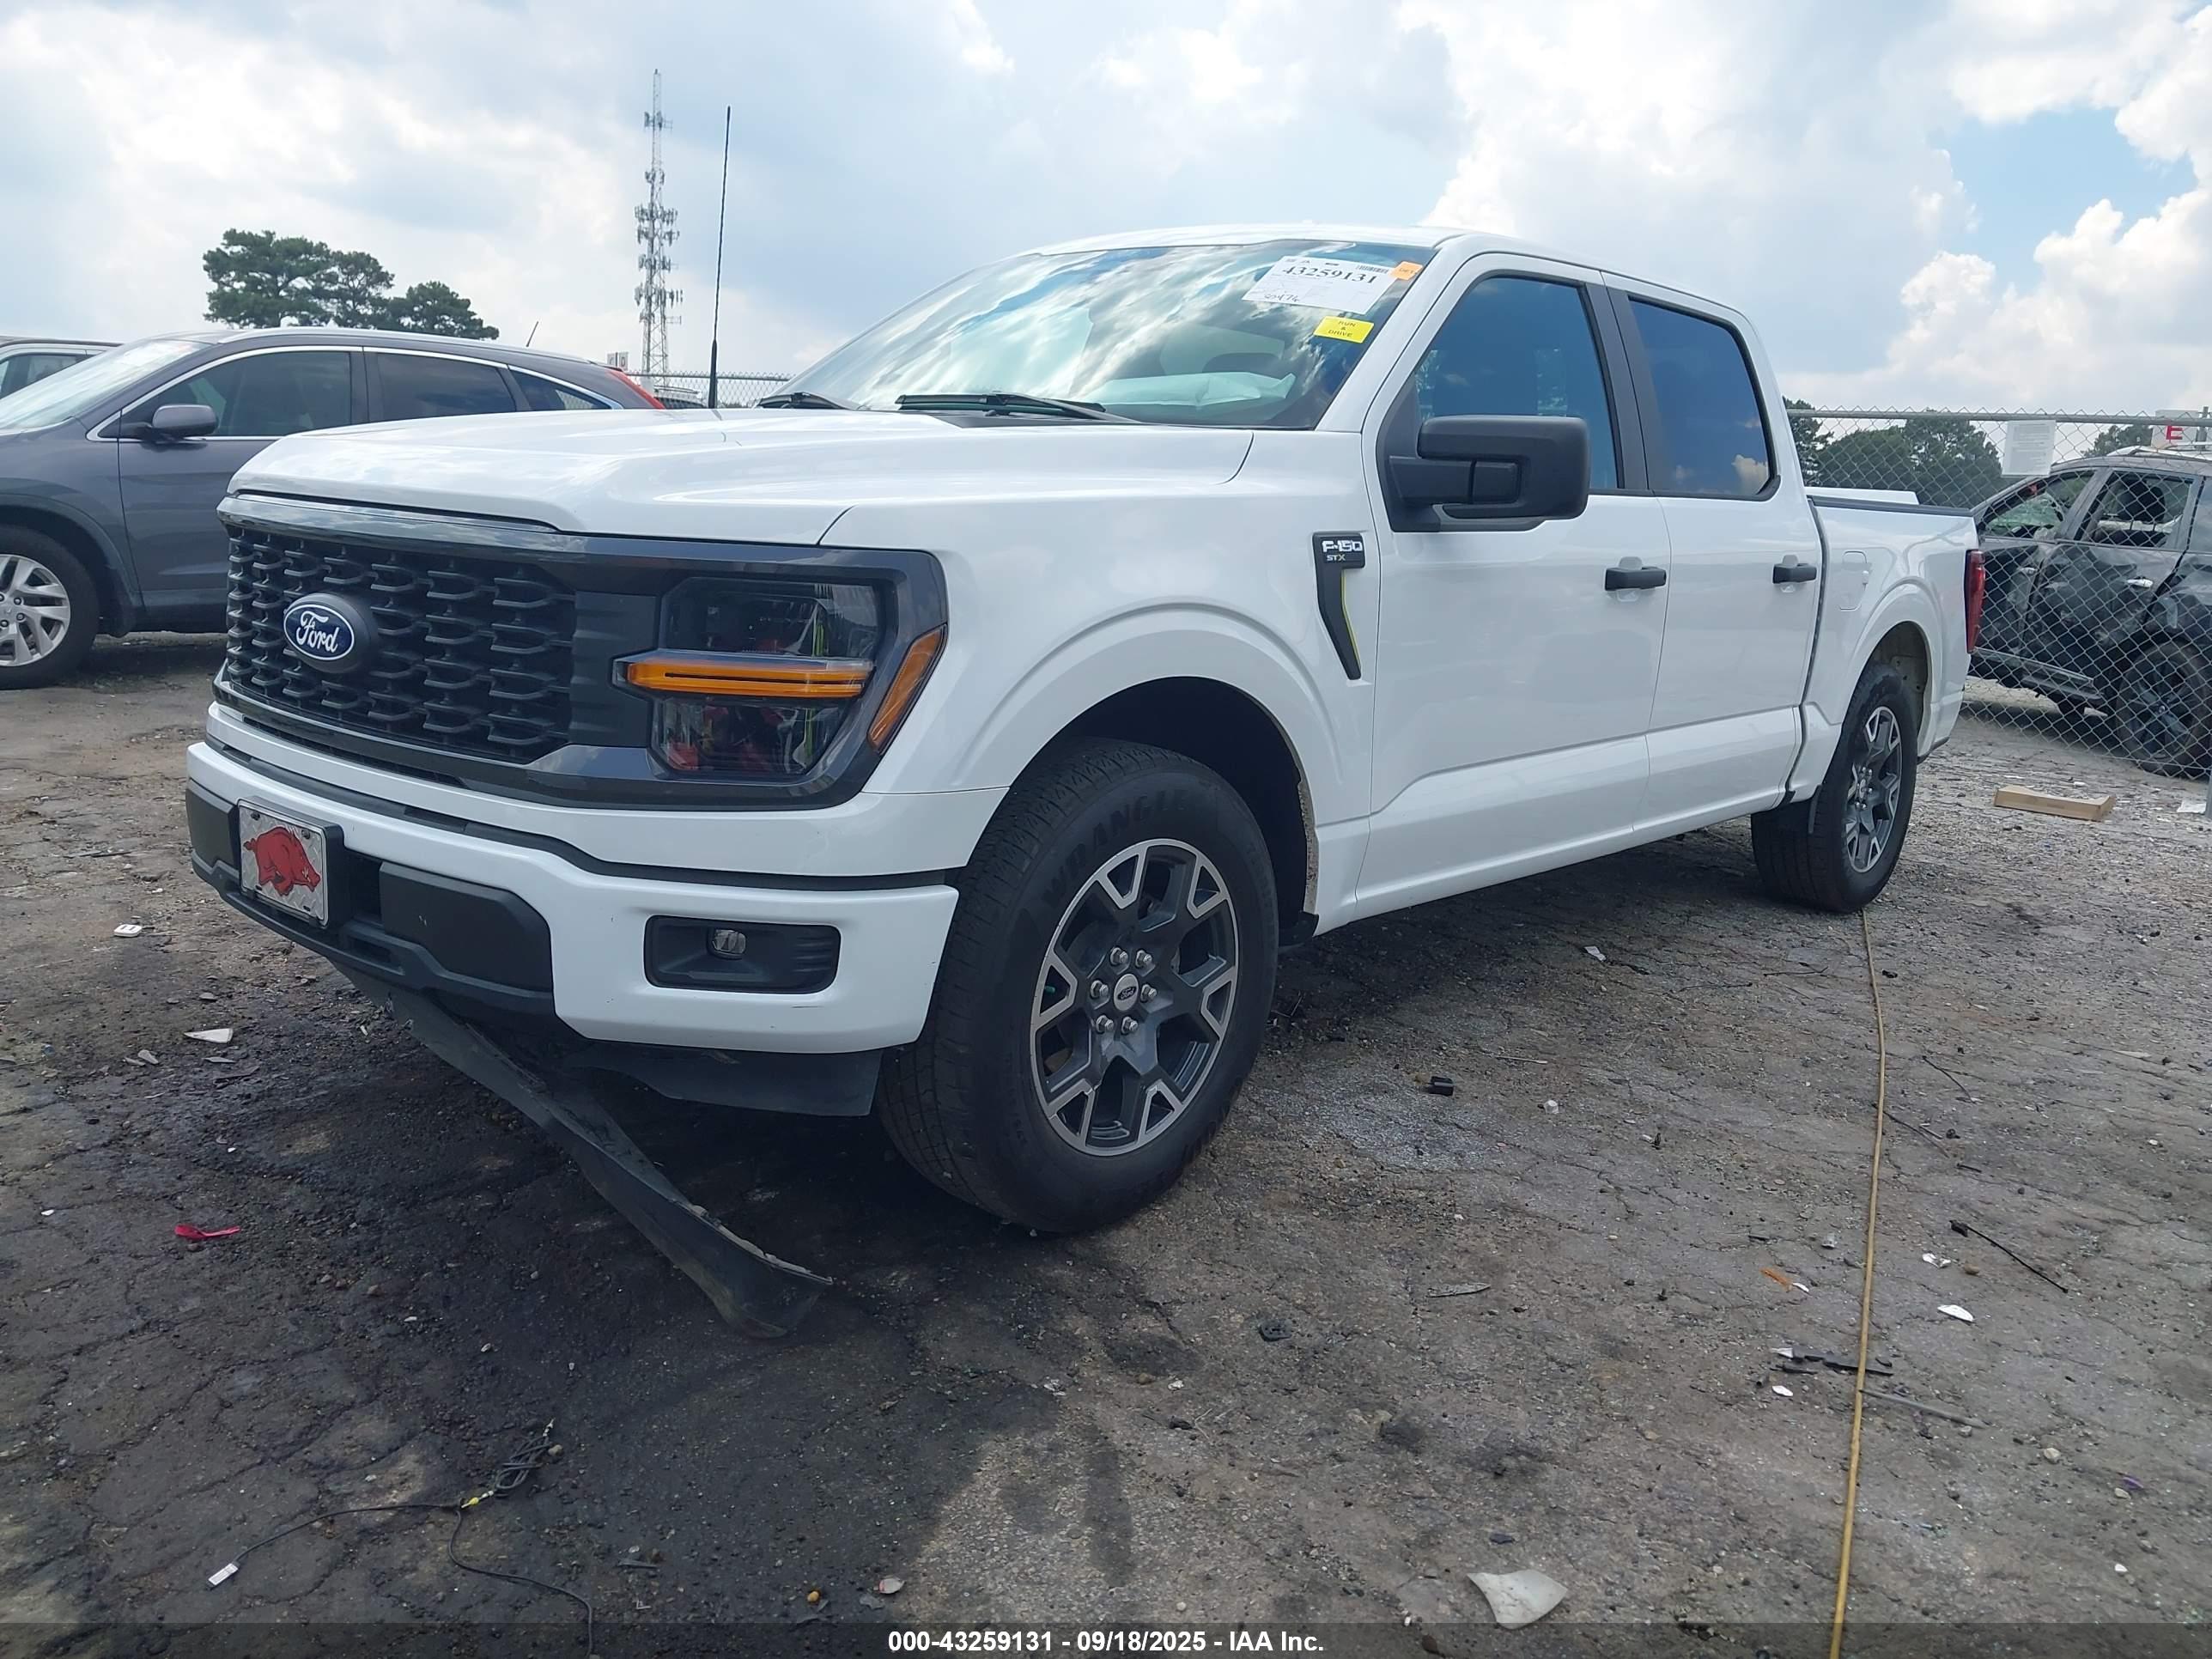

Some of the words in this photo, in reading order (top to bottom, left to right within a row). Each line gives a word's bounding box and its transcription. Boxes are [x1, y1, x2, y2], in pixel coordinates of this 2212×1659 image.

[1283, 265, 1377, 284] 43259131
[1328, 329, 1353, 337] DRIVE
[1322, 539, 1364, 553] F-150
[295, 610, 340, 653] Ford
